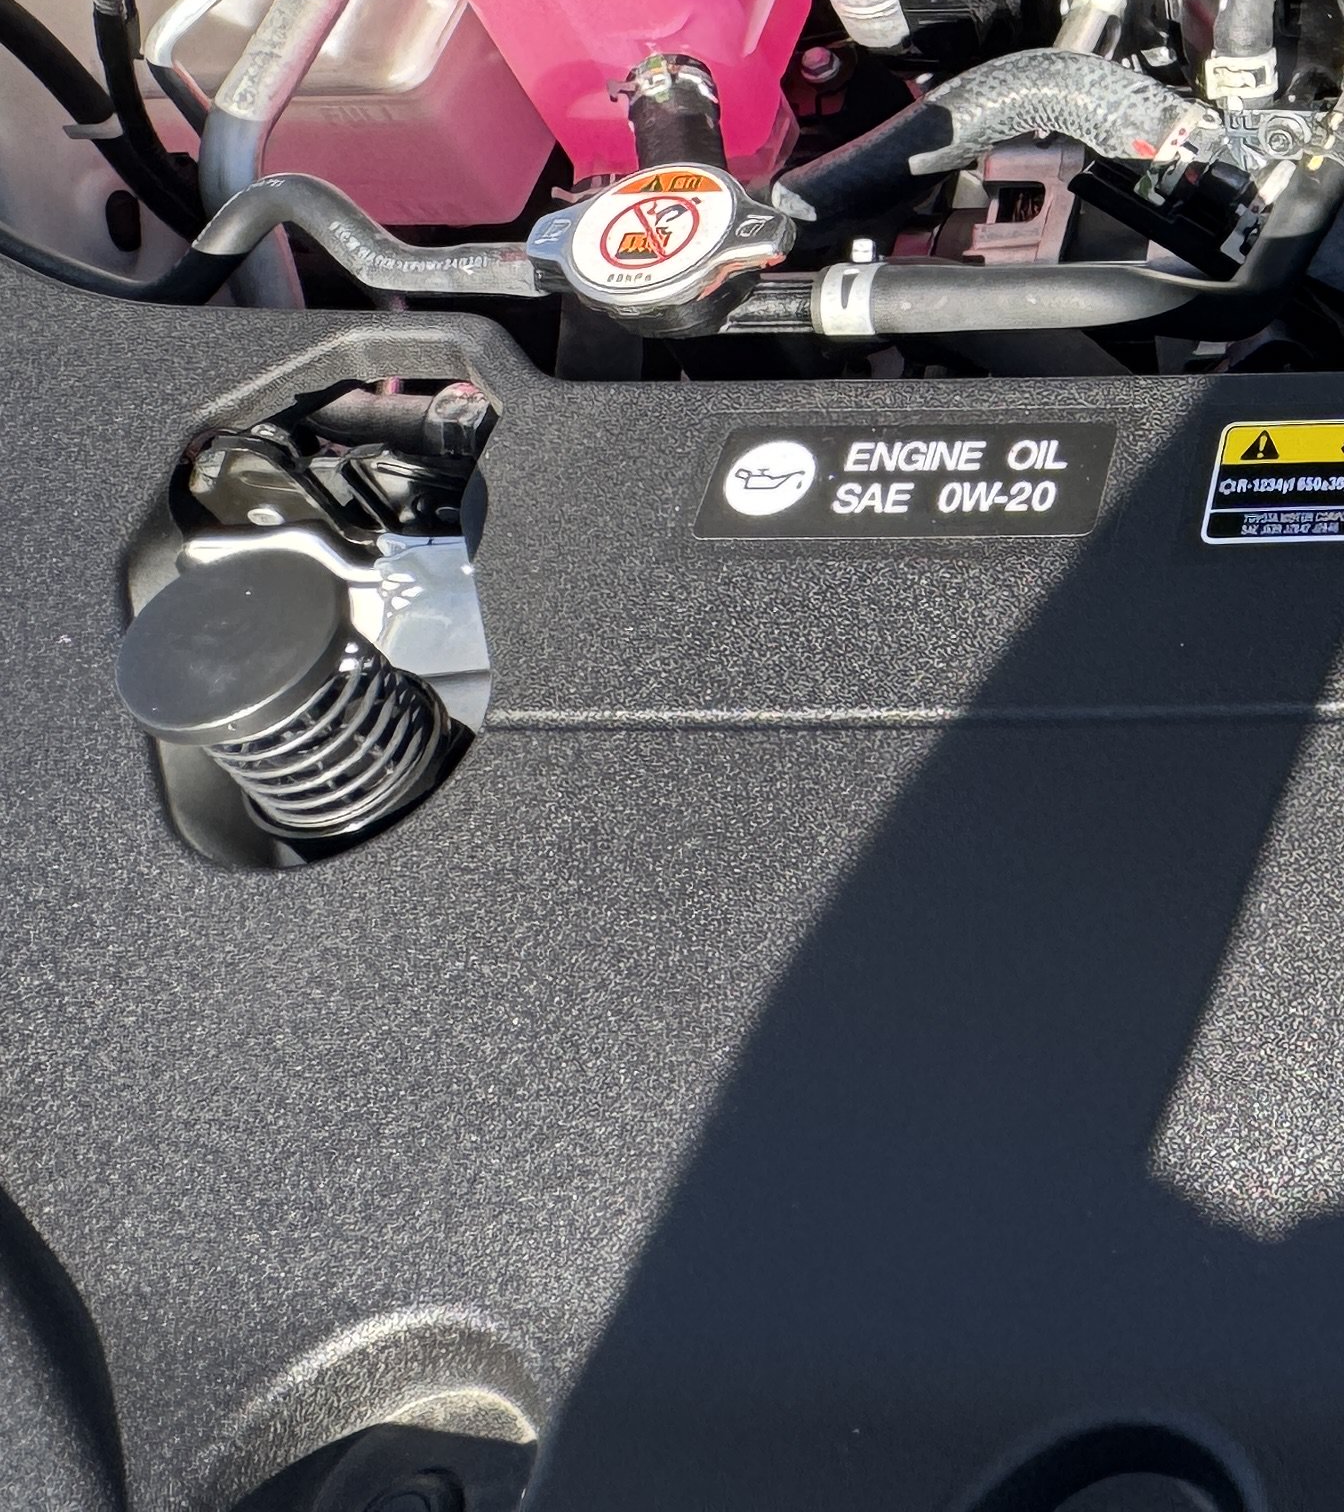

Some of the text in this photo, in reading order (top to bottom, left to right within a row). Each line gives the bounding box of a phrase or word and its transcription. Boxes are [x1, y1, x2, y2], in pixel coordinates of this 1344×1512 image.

[844, 439, 1069, 473] ENGINE OIL
[831, 481, 1056, 514] SAE 0W-20
